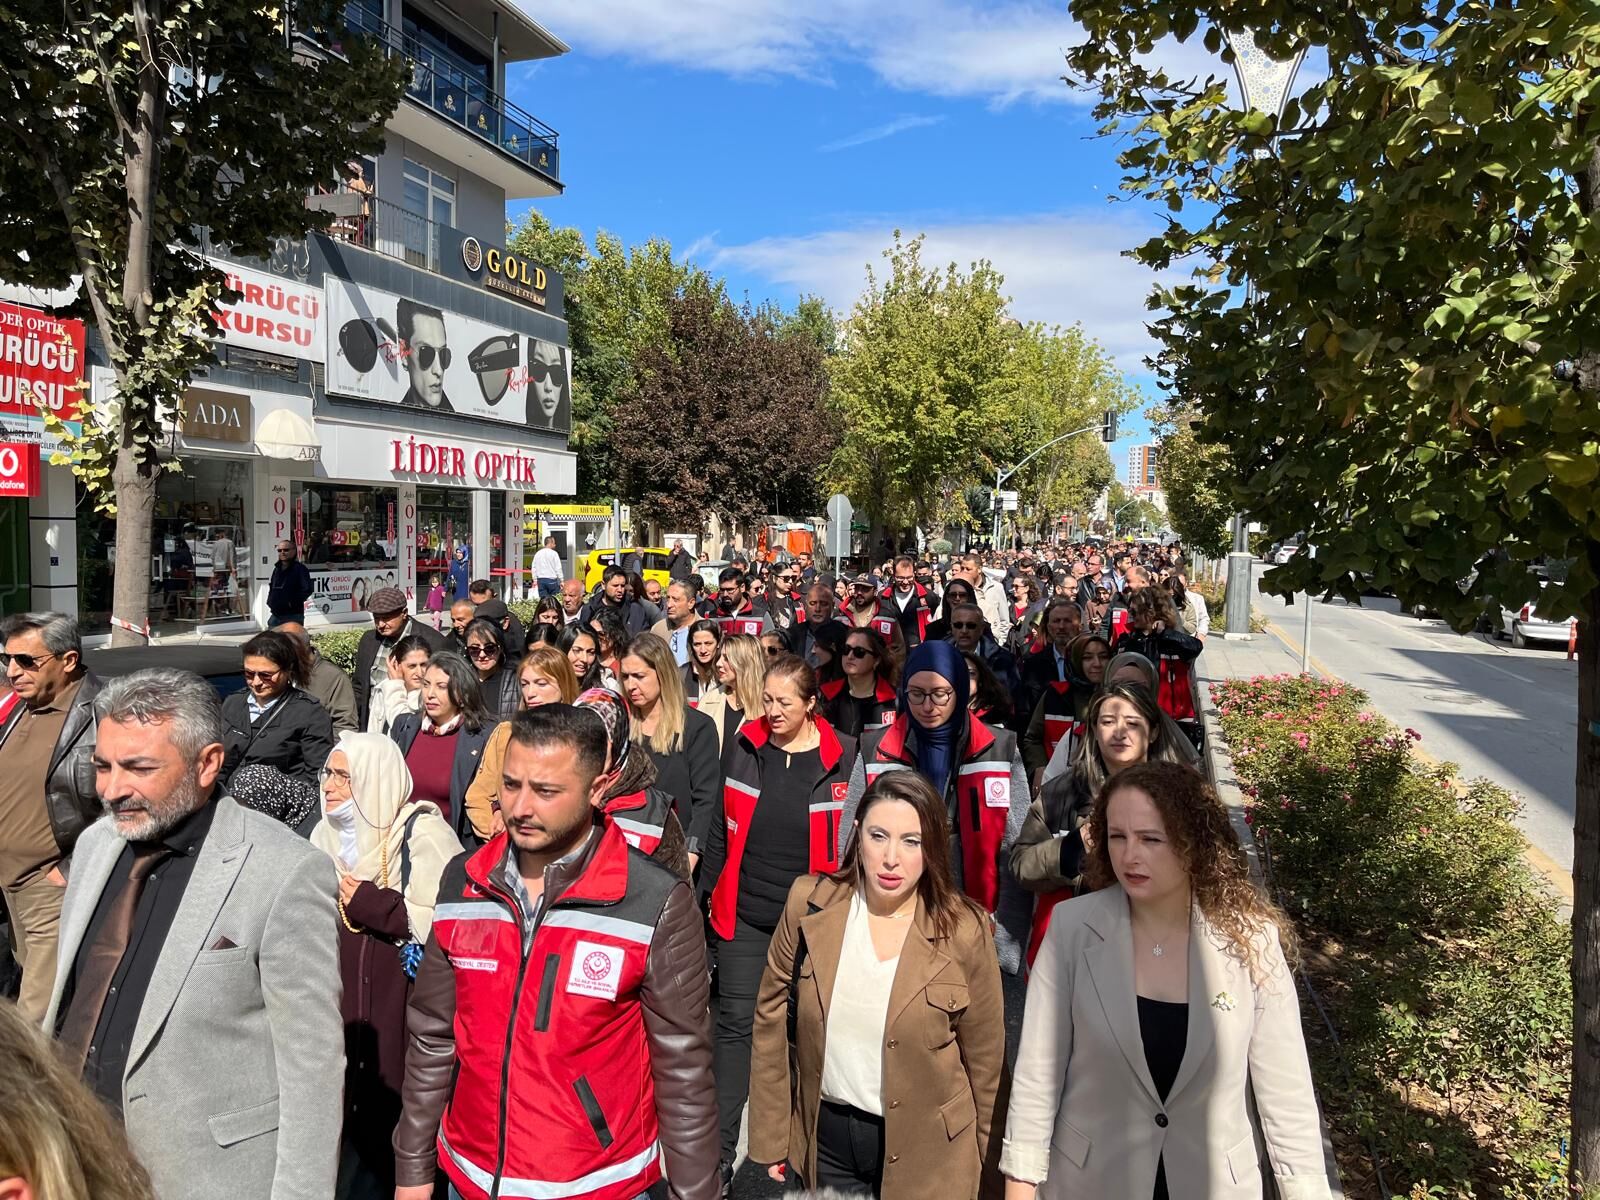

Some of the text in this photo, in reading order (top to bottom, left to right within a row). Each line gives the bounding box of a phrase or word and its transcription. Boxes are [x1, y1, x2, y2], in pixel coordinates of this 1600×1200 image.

[487, 248, 547, 290] GOLD
[224, 272, 319, 320] ÜRÜCÜ
[27, 317, 66, 336] OPTİK
[210, 309, 312, 347] KURSU
[0, 327, 76, 373] RÜCÜ
[194, 403, 240, 428] ADA
[391, 435, 536, 483] LİDER OPTİK
[0, 480, 25, 489] dafone
[310, 576, 330, 593] TİK
